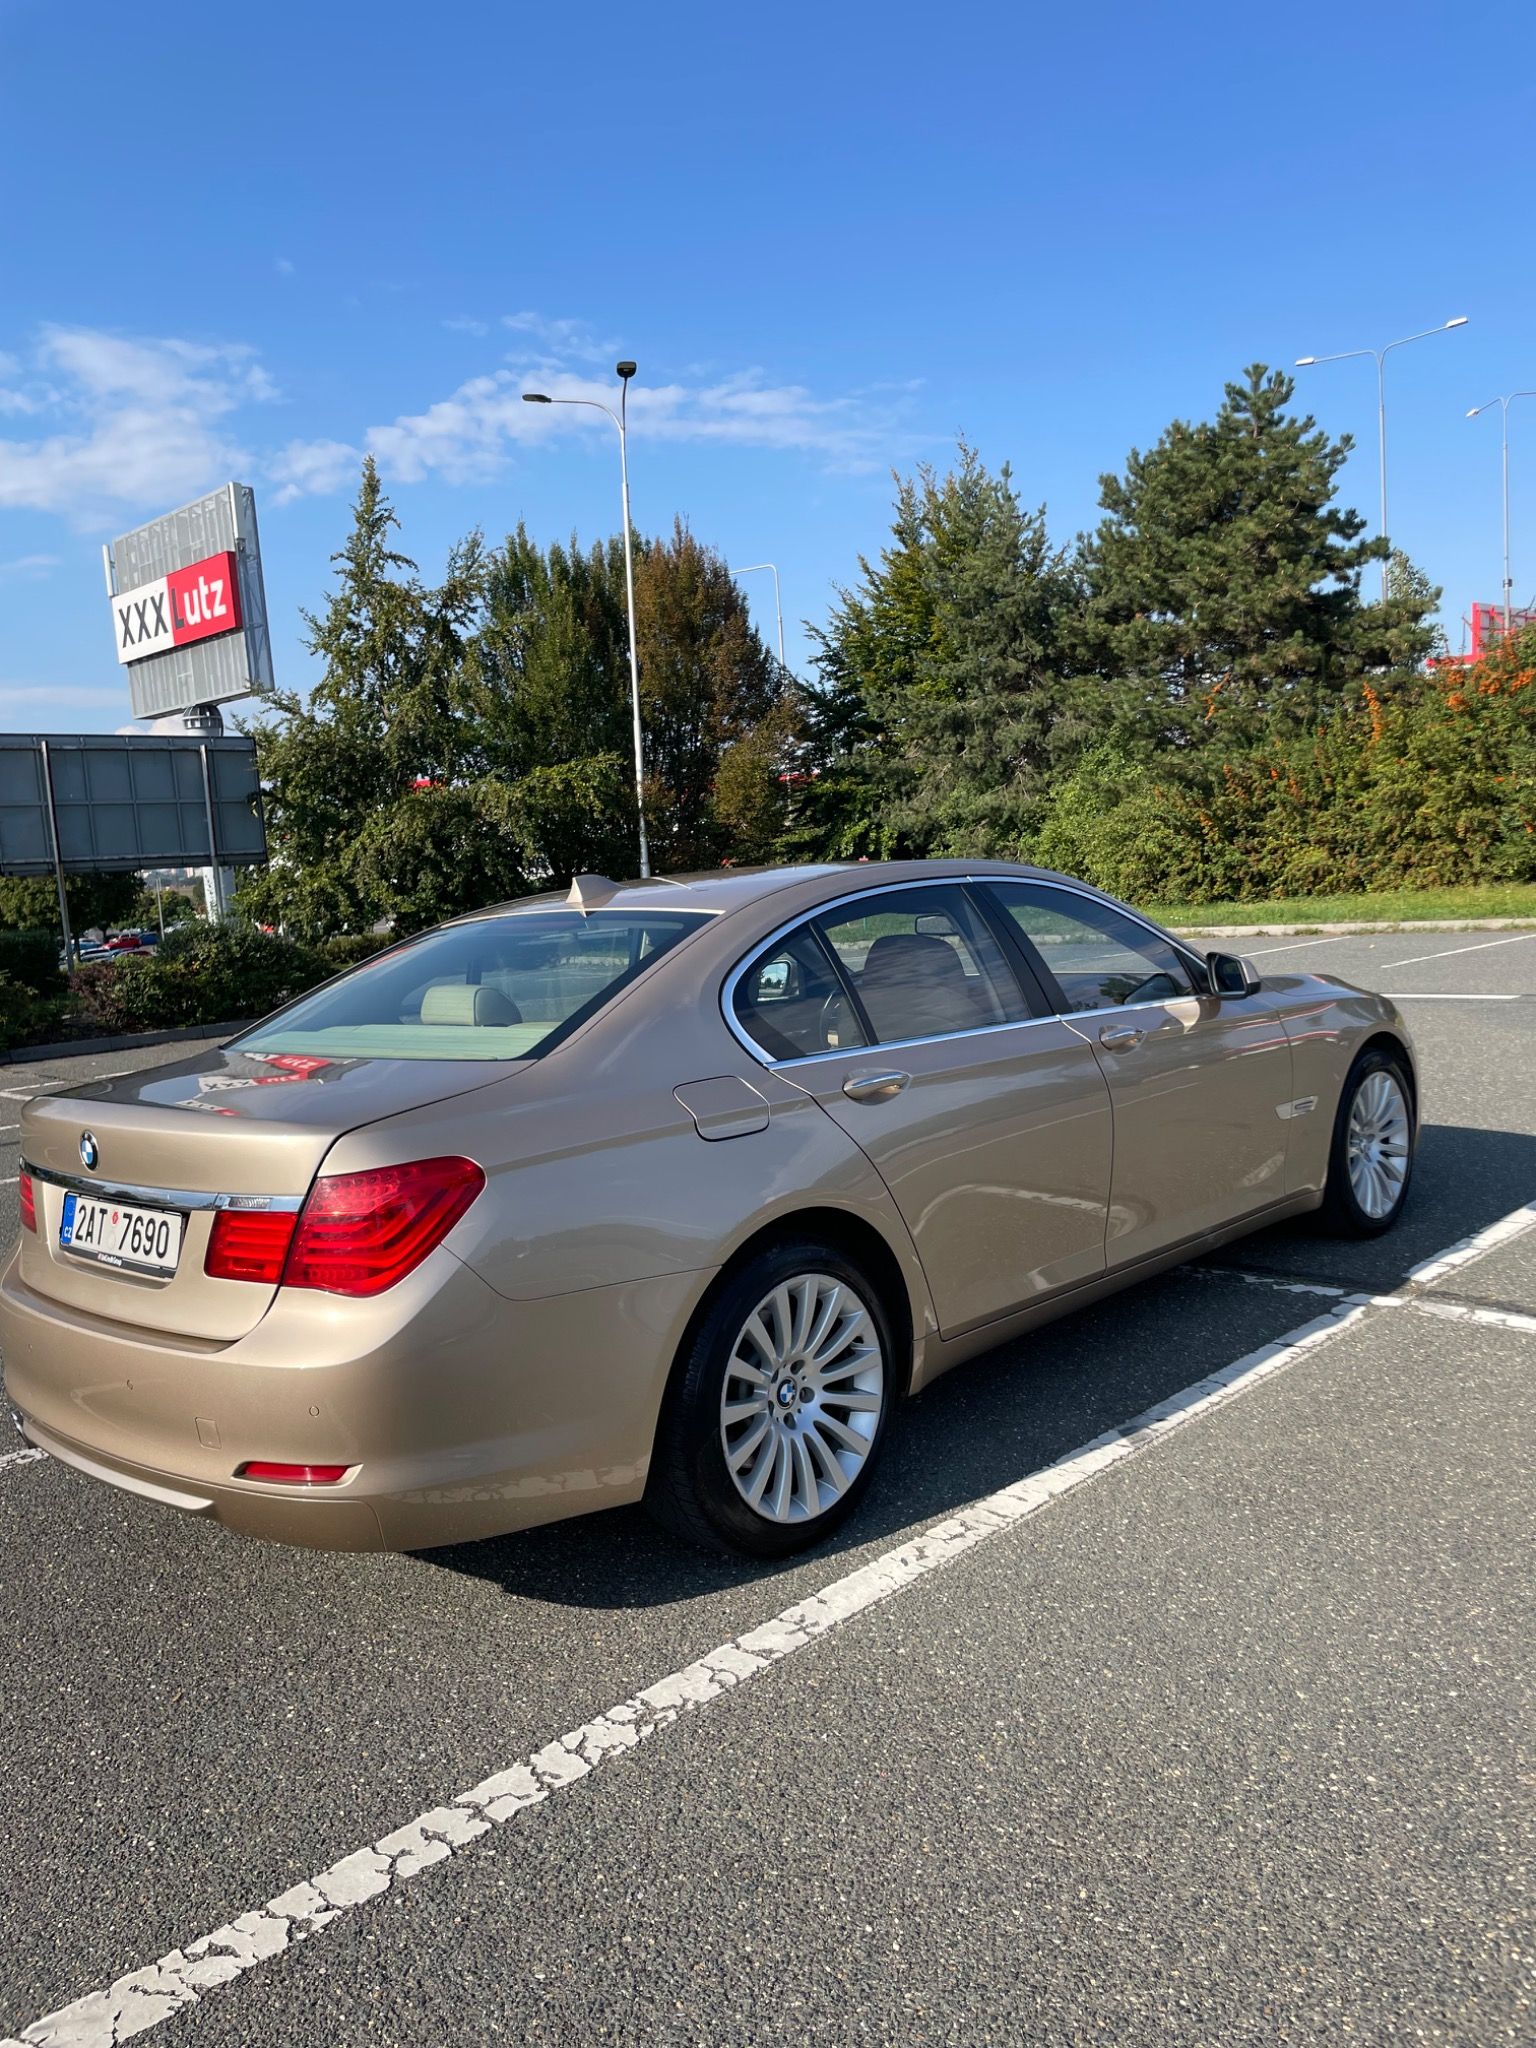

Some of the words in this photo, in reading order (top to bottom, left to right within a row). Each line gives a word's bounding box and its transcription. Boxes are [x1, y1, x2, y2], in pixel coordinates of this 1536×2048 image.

[64, 1226, 73, 1239] CZ
[75, 1204, 108, 1246] 2AT
[118, 1212, 170, 1259] 7690
